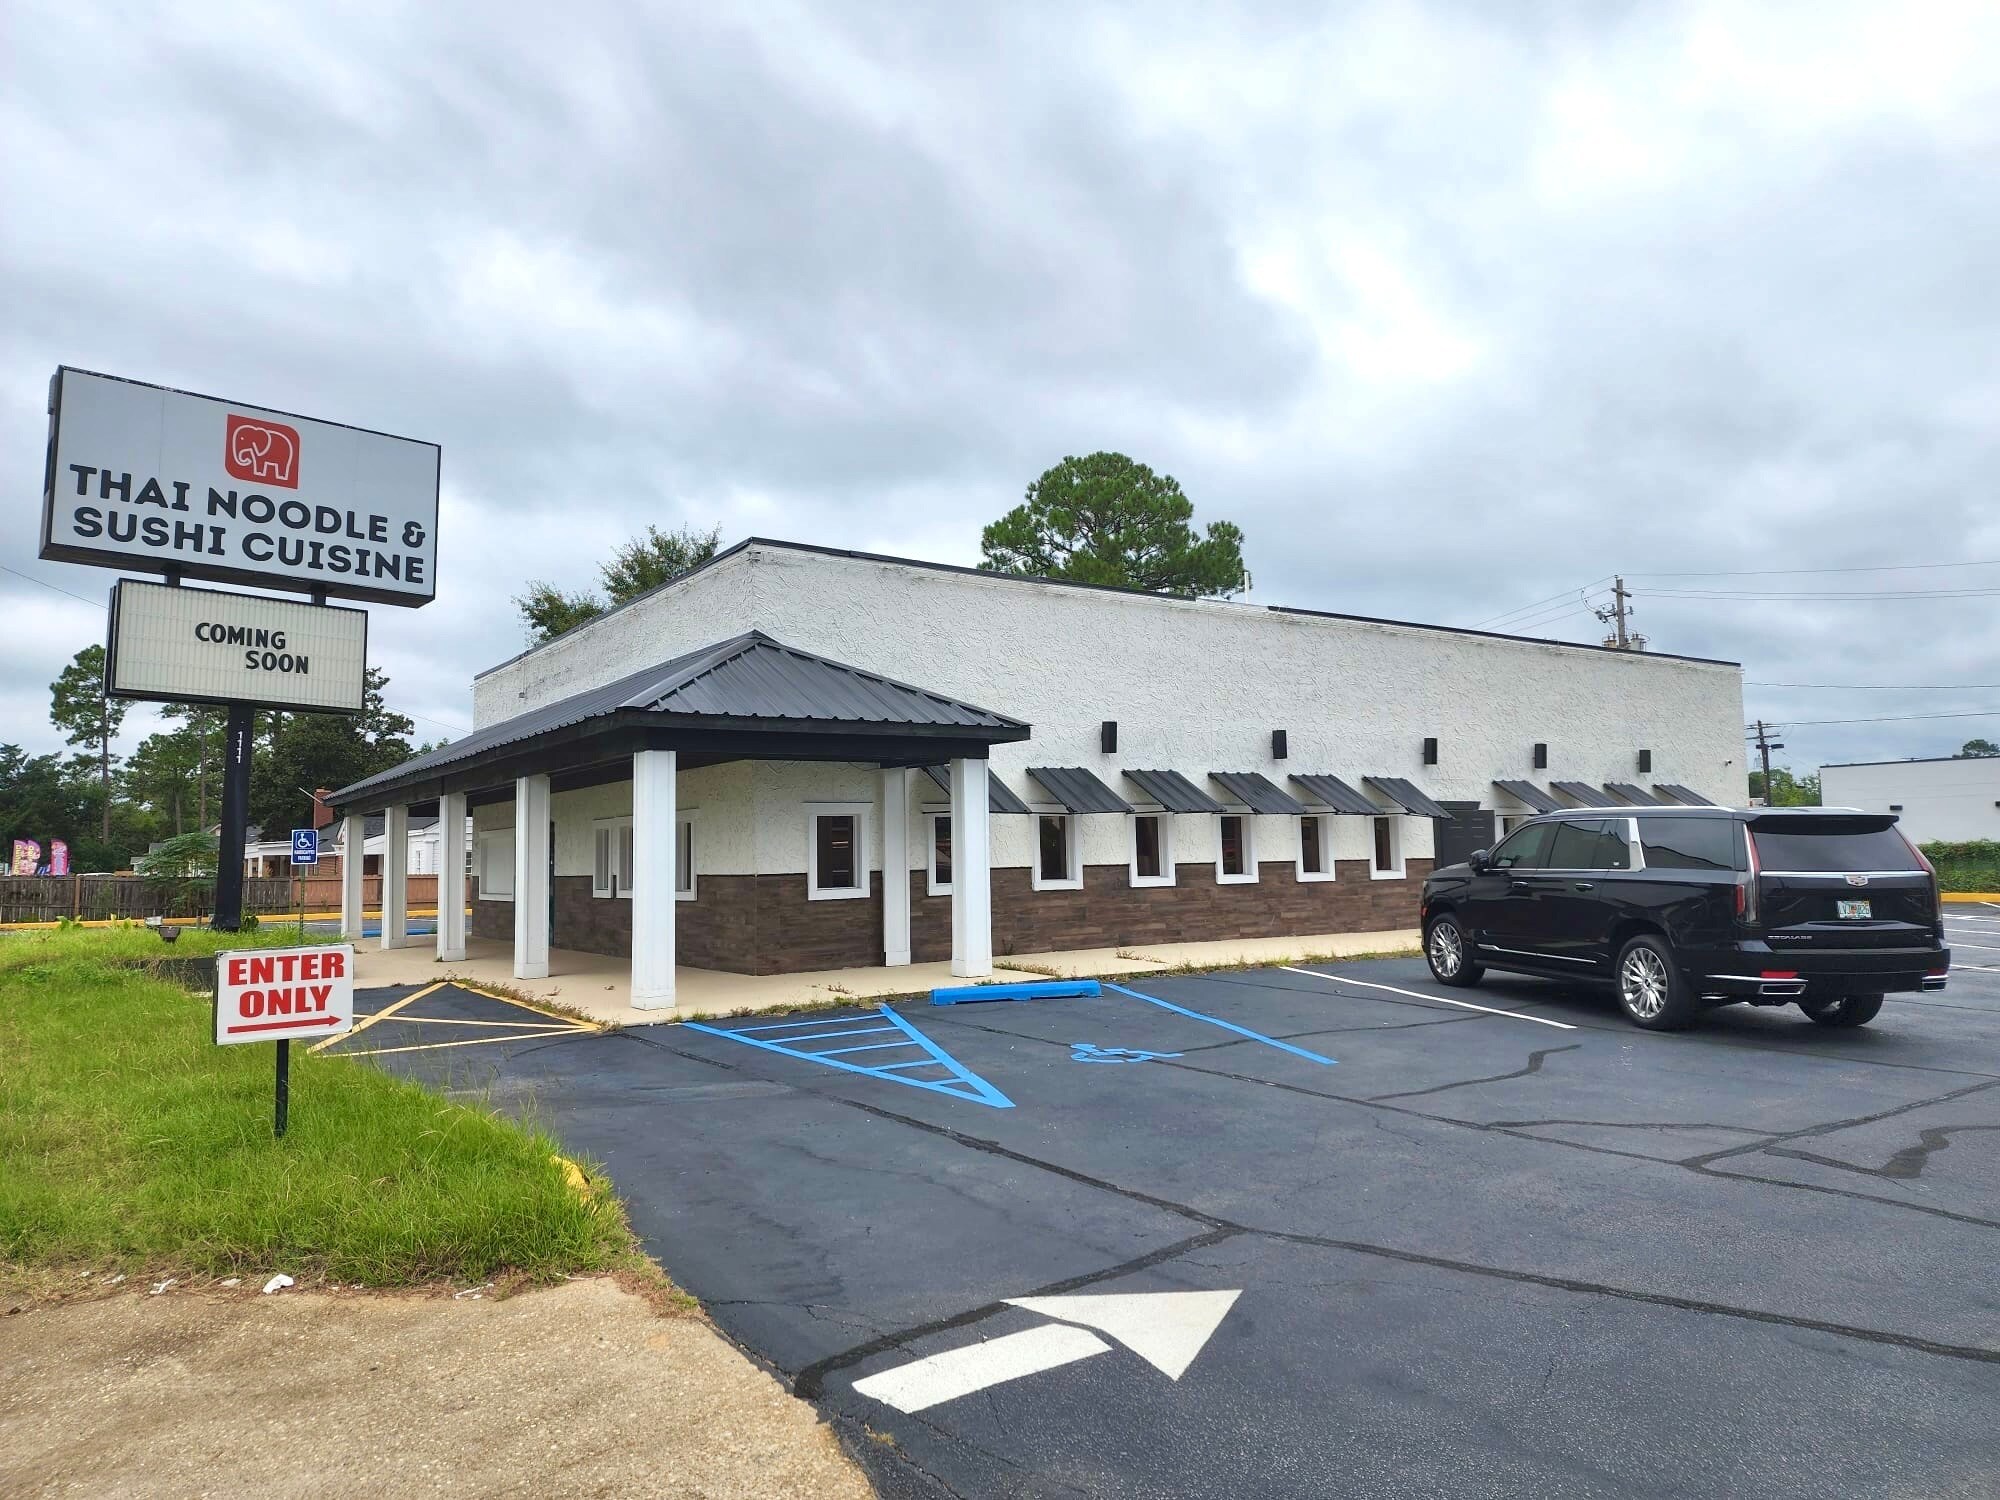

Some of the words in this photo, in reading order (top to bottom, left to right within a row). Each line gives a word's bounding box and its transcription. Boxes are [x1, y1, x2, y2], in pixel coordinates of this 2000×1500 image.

[70, 464, 191, 512] THAI
[208, 488, 388, 544] NOODLE
[402, 520, 426, 549] &
[73, 507, 226, 556] SUSHI
[242, 532, 424, 584] CUISINE
[195, 622, 286, 651] COMING
[245, 649, 309, 675] SOON
[228, 952, 344, 986] ENTER
[239, 985, 332, 1018] ONLY
